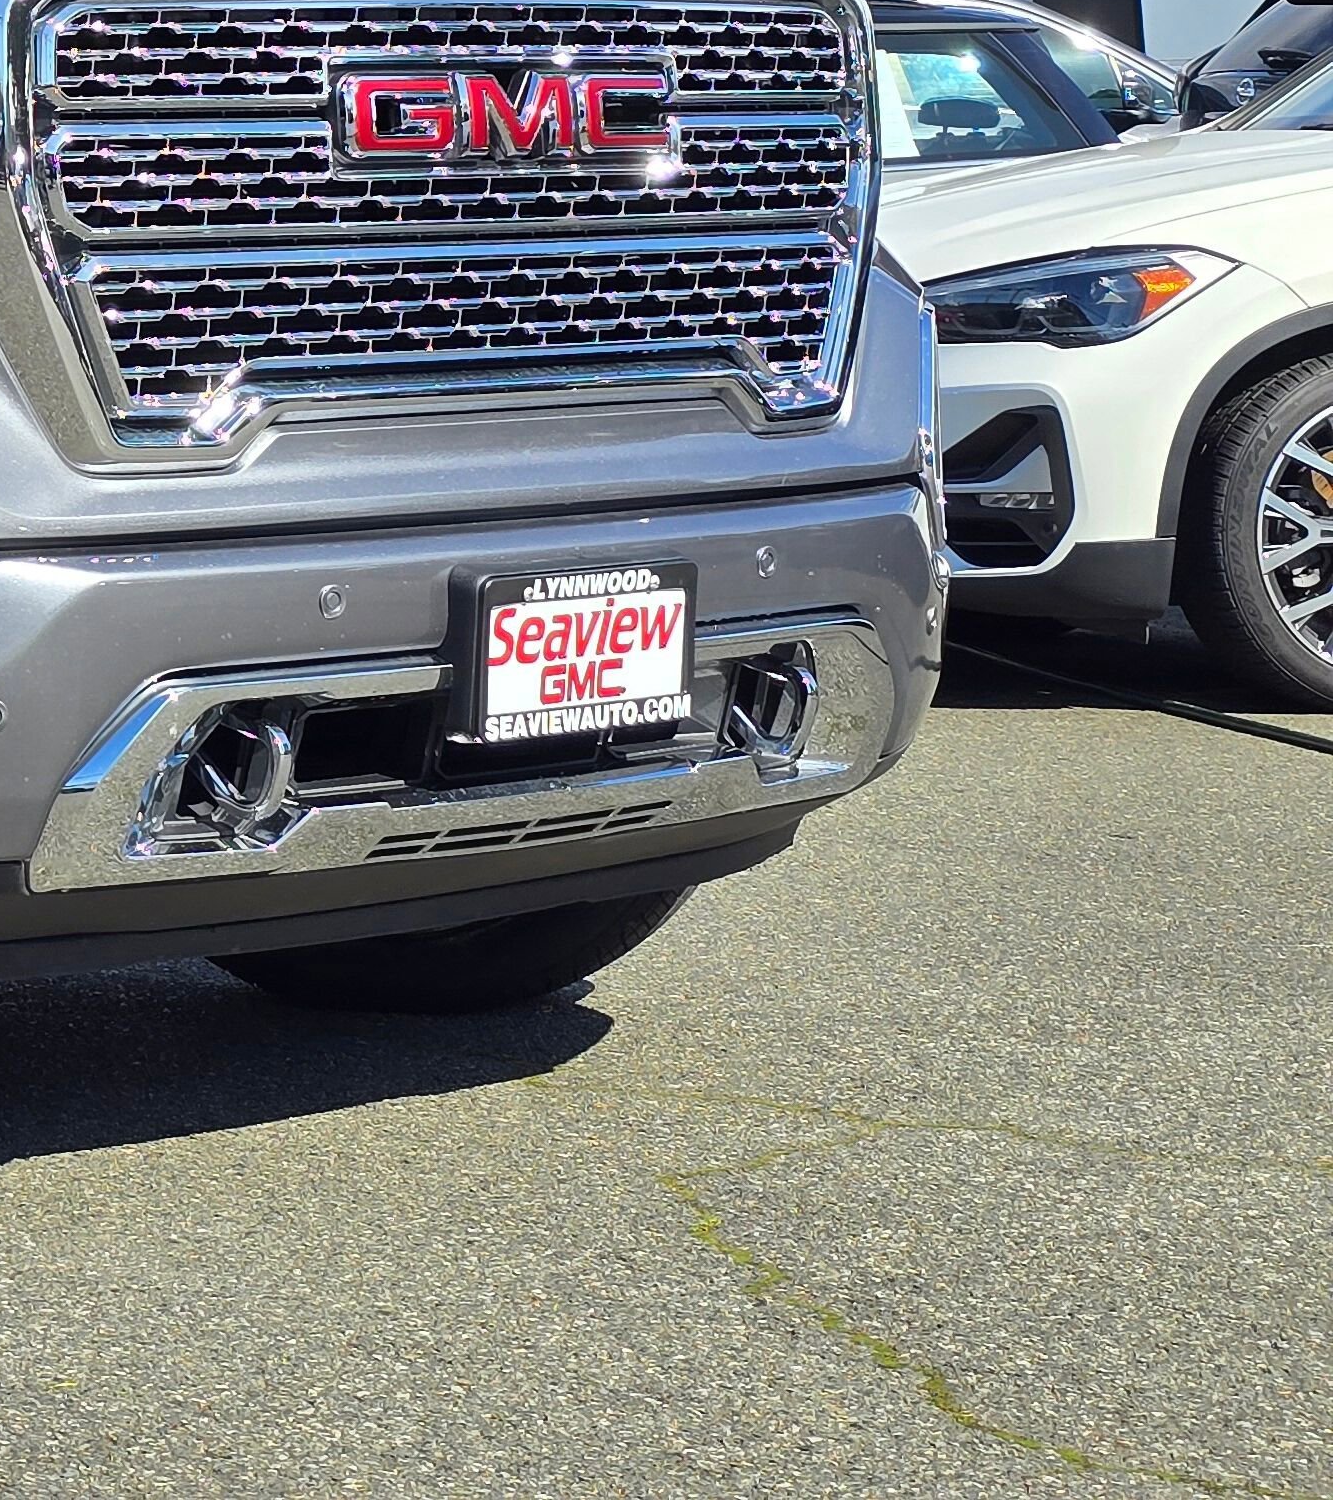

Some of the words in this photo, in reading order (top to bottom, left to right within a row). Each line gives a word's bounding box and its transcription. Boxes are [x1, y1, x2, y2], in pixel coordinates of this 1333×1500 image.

[343, 70, 671, 158] GMC
[532, 568, 652, 601] LYNNWOOD
[485, 597, 683, 667] Seaview
[539, 657, 627, 706] GMC
[484, 694, 692, 742] SEAVIEWAUTO.COM
